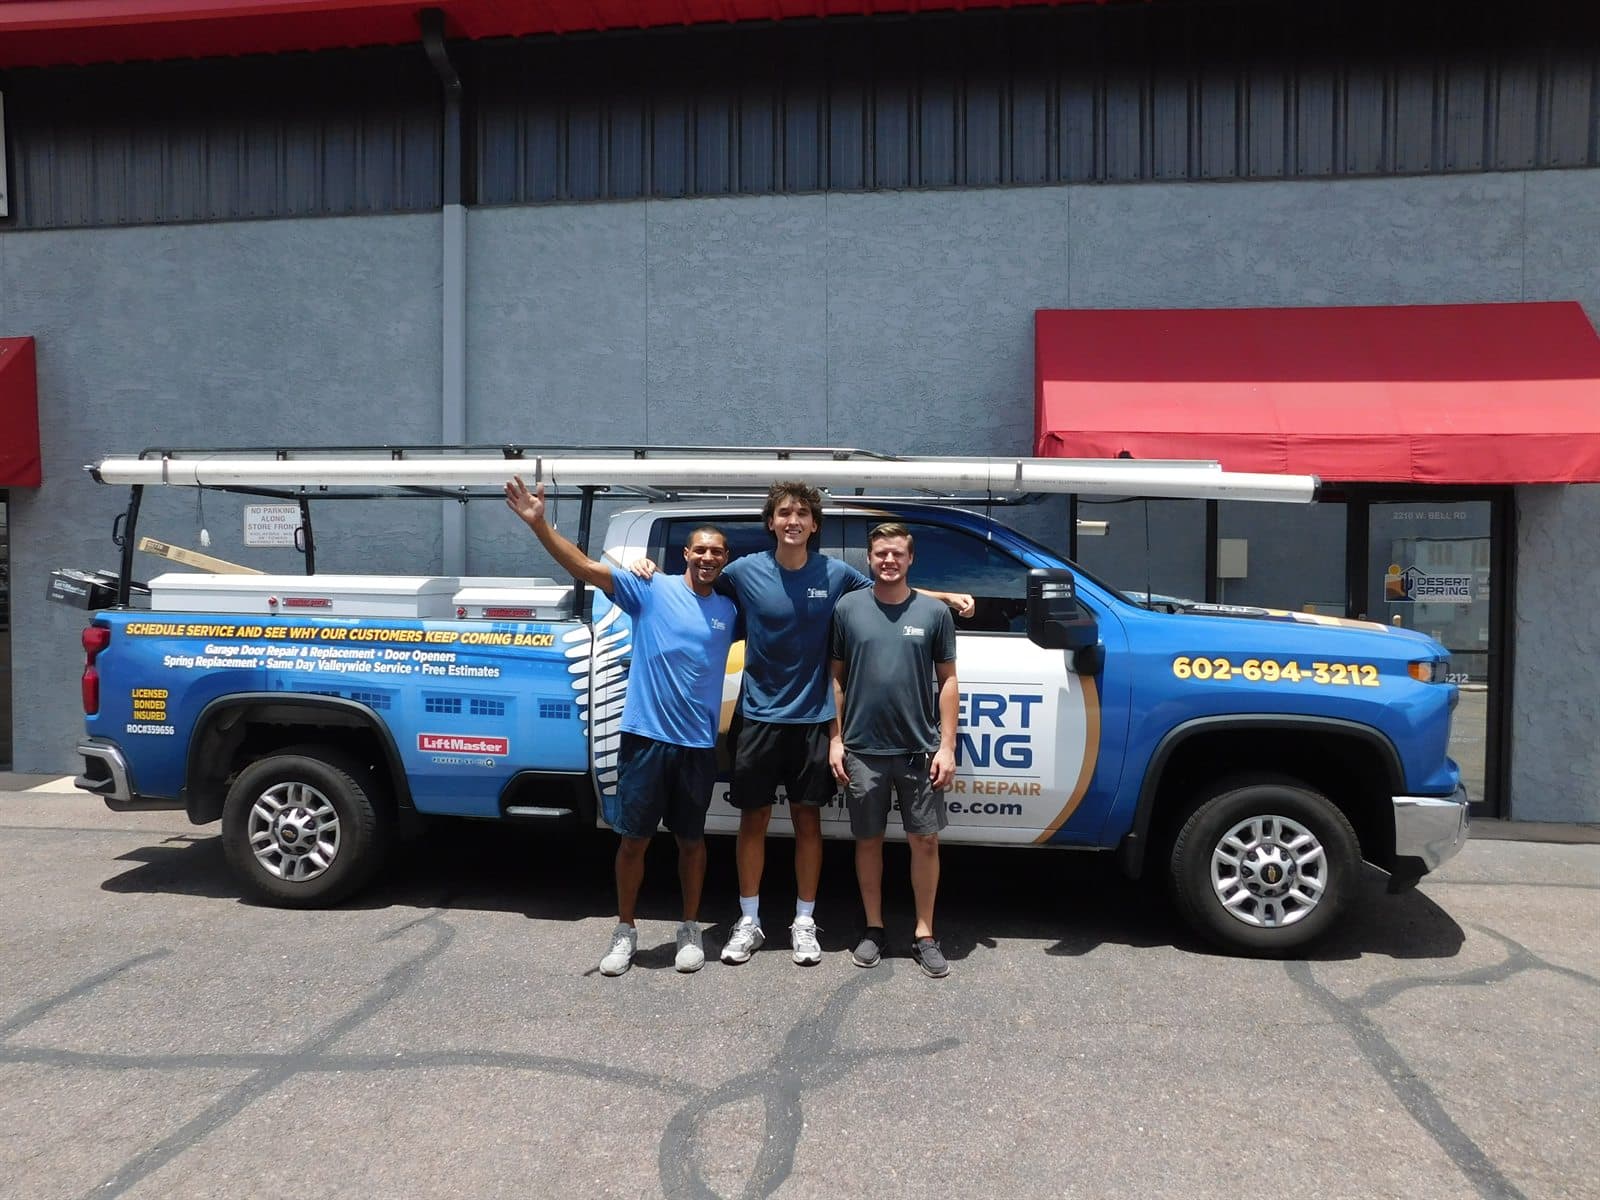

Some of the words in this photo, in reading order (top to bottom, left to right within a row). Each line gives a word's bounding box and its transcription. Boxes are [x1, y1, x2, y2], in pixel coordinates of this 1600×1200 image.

[1428, 512, 1452, 520] BELL
[1454, 512, 1466, 520] RD
[1417, 577, 1471, 586] DESERT
[1417, 586, 1468, 595] SPRING
[126, 623, 185, 636] SCHEDULE
[186, 624, 234, 637] SERVICE
[235, 626, 263, 638] AND
[264, 627, 286, 638] SEE
[289, 627, 318, 640] WHY
[320, 628, 347, 640] OUR
[349, 628, 423, 643] CUSTOMERS
[424, 631, 459, 643] KEEP
[460, 632, 512, 645] COMING
[513, 634, 554, 647] BACK!
[204, 643, 239, 657] Garage
[240, 644, 266, 656] Door
[267, 645, 299, 658] Repair
[300, 647, 308, 657] &
[309, 646, 375, 660] Replacement
[384, 649, 411, 661] Door
[412, 650, 456, 664] Openers
[163, 655, 195, 670] Spring
[195, 656, 257, 669] Replacement
[266, 659, 295, 670] Same
[295, 659, 317, 673] Day
[318, 659, 373, 675] Valleywide
[373, 661, 412, 674] Service
[422, 664, 446, 676] Free
[448, 665, 500, 678] Estimates
[1172, 656, 1381, 688] 602-694-3212
[131, 688, 169, 699] LICENSED
[134, 699, 166, 710] BONDED
[133, 710, 167, 721] INSURED
[423, 737, 503, 752] LiftMaster
[972, 780, 1042, 796] REPAIR
